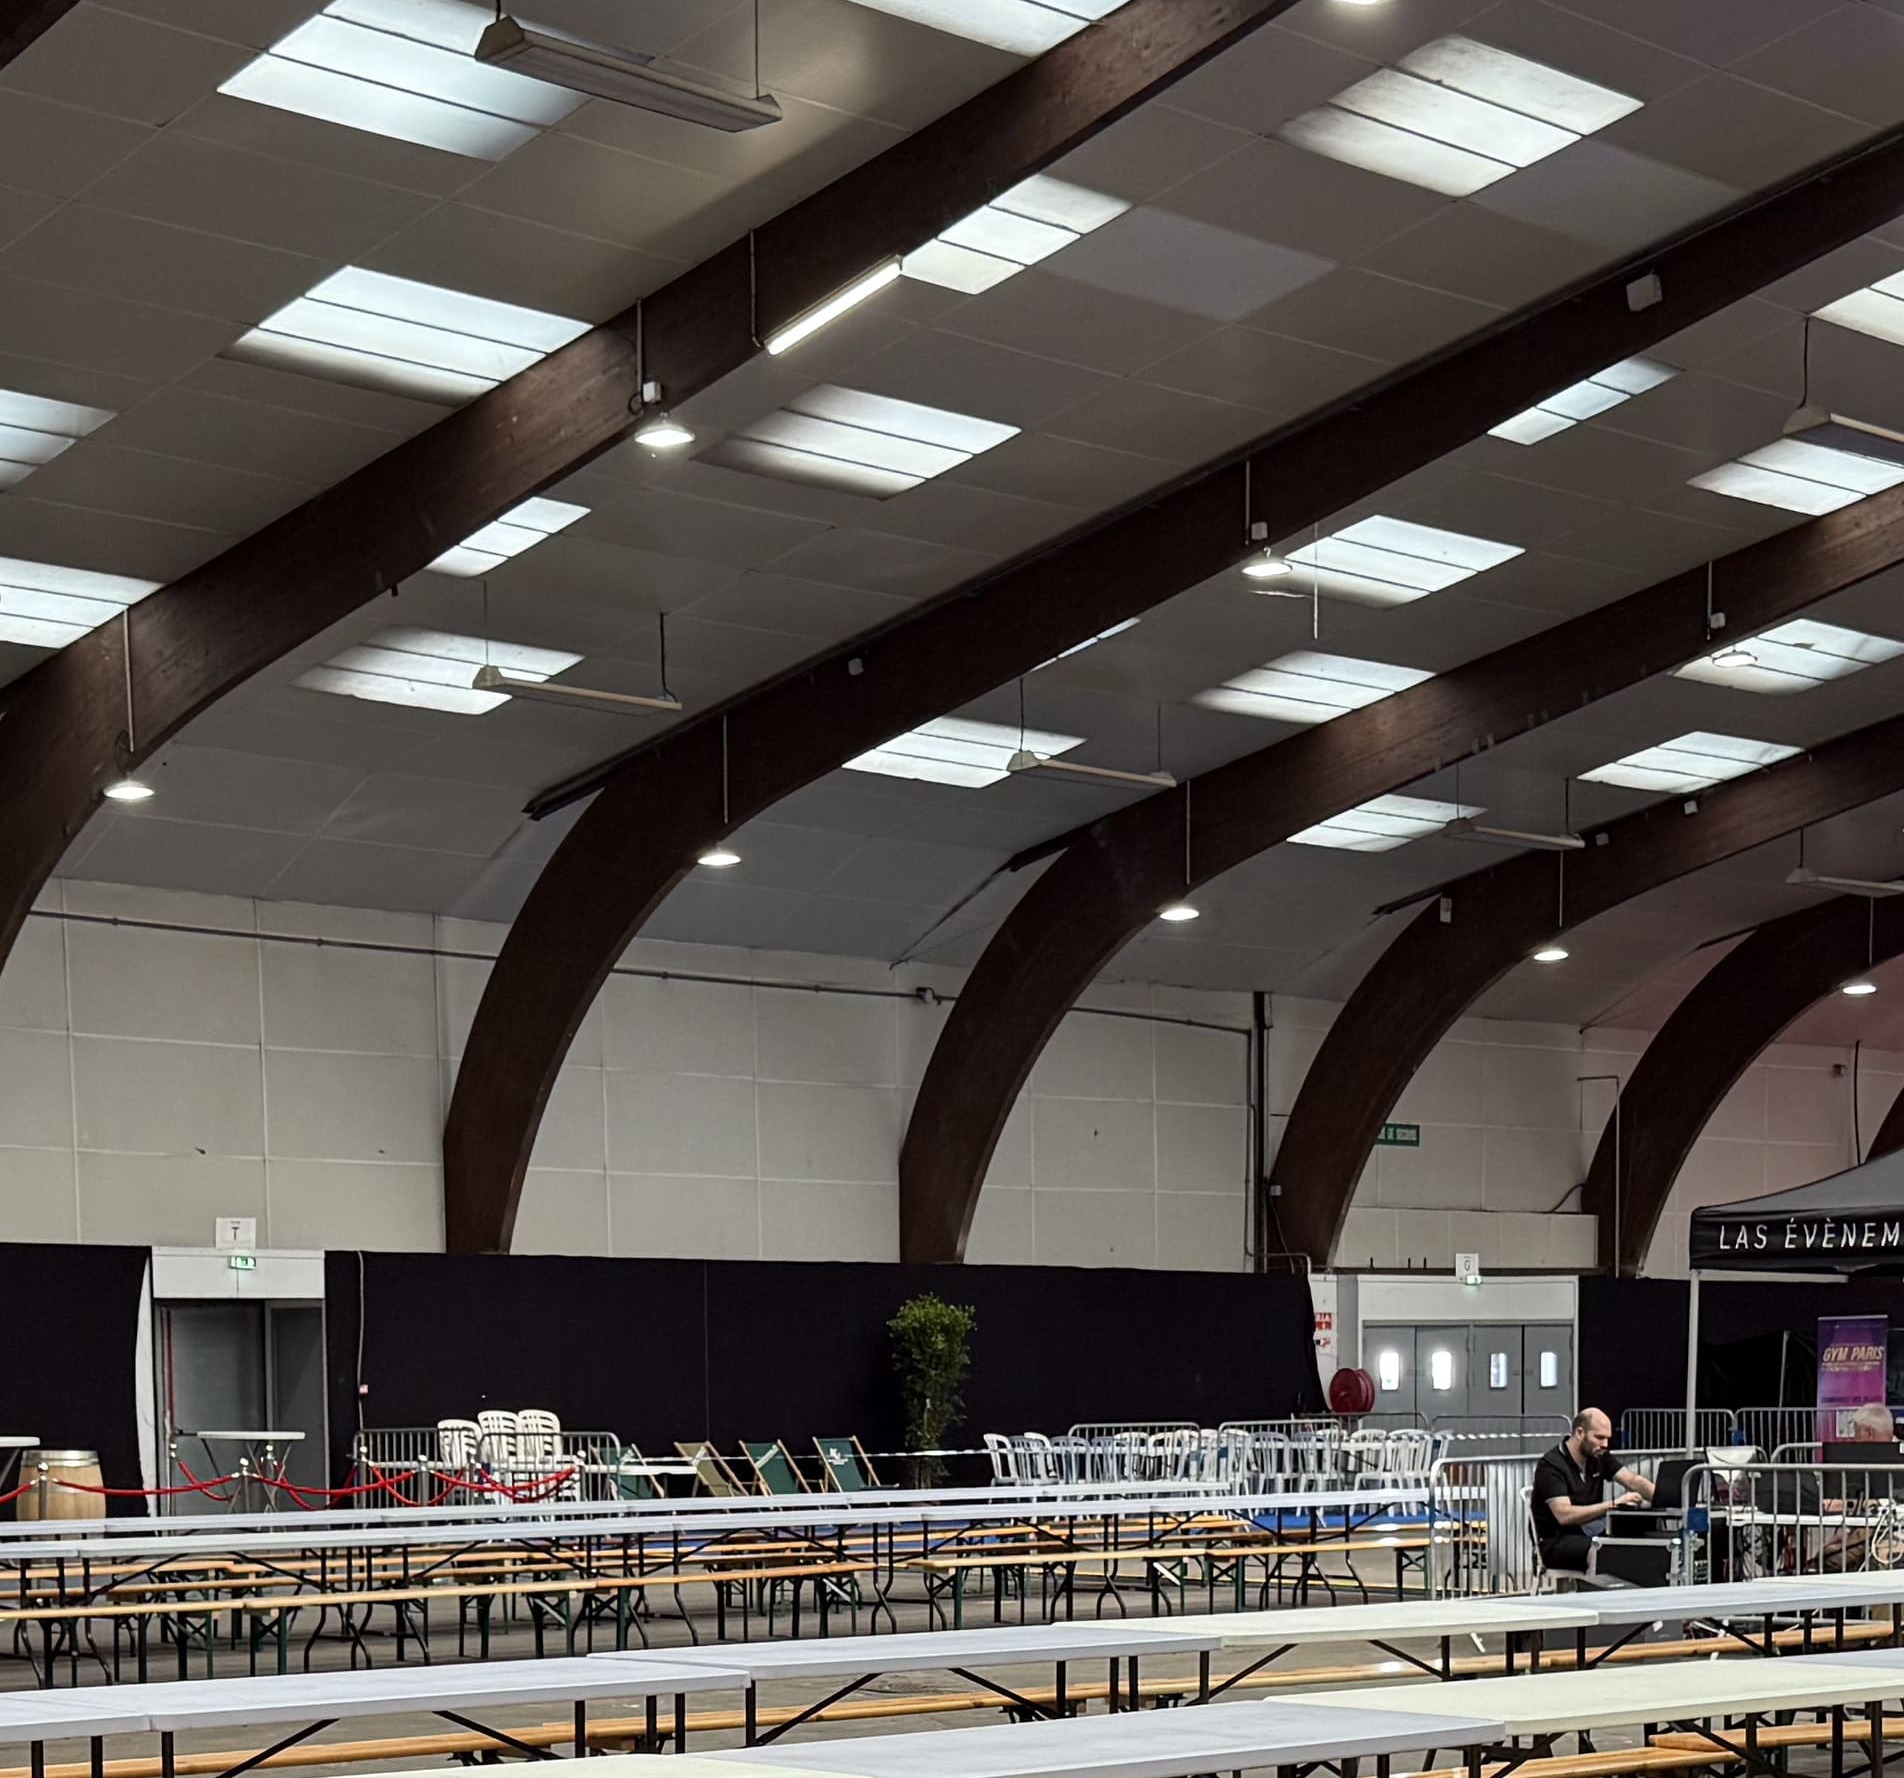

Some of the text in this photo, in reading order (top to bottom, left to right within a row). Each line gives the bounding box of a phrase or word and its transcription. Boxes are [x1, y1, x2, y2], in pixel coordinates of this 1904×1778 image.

[1719, 1224, 1769, 1250] LAS
[1823, 1345, 1885, 1362] GYM PARIS
